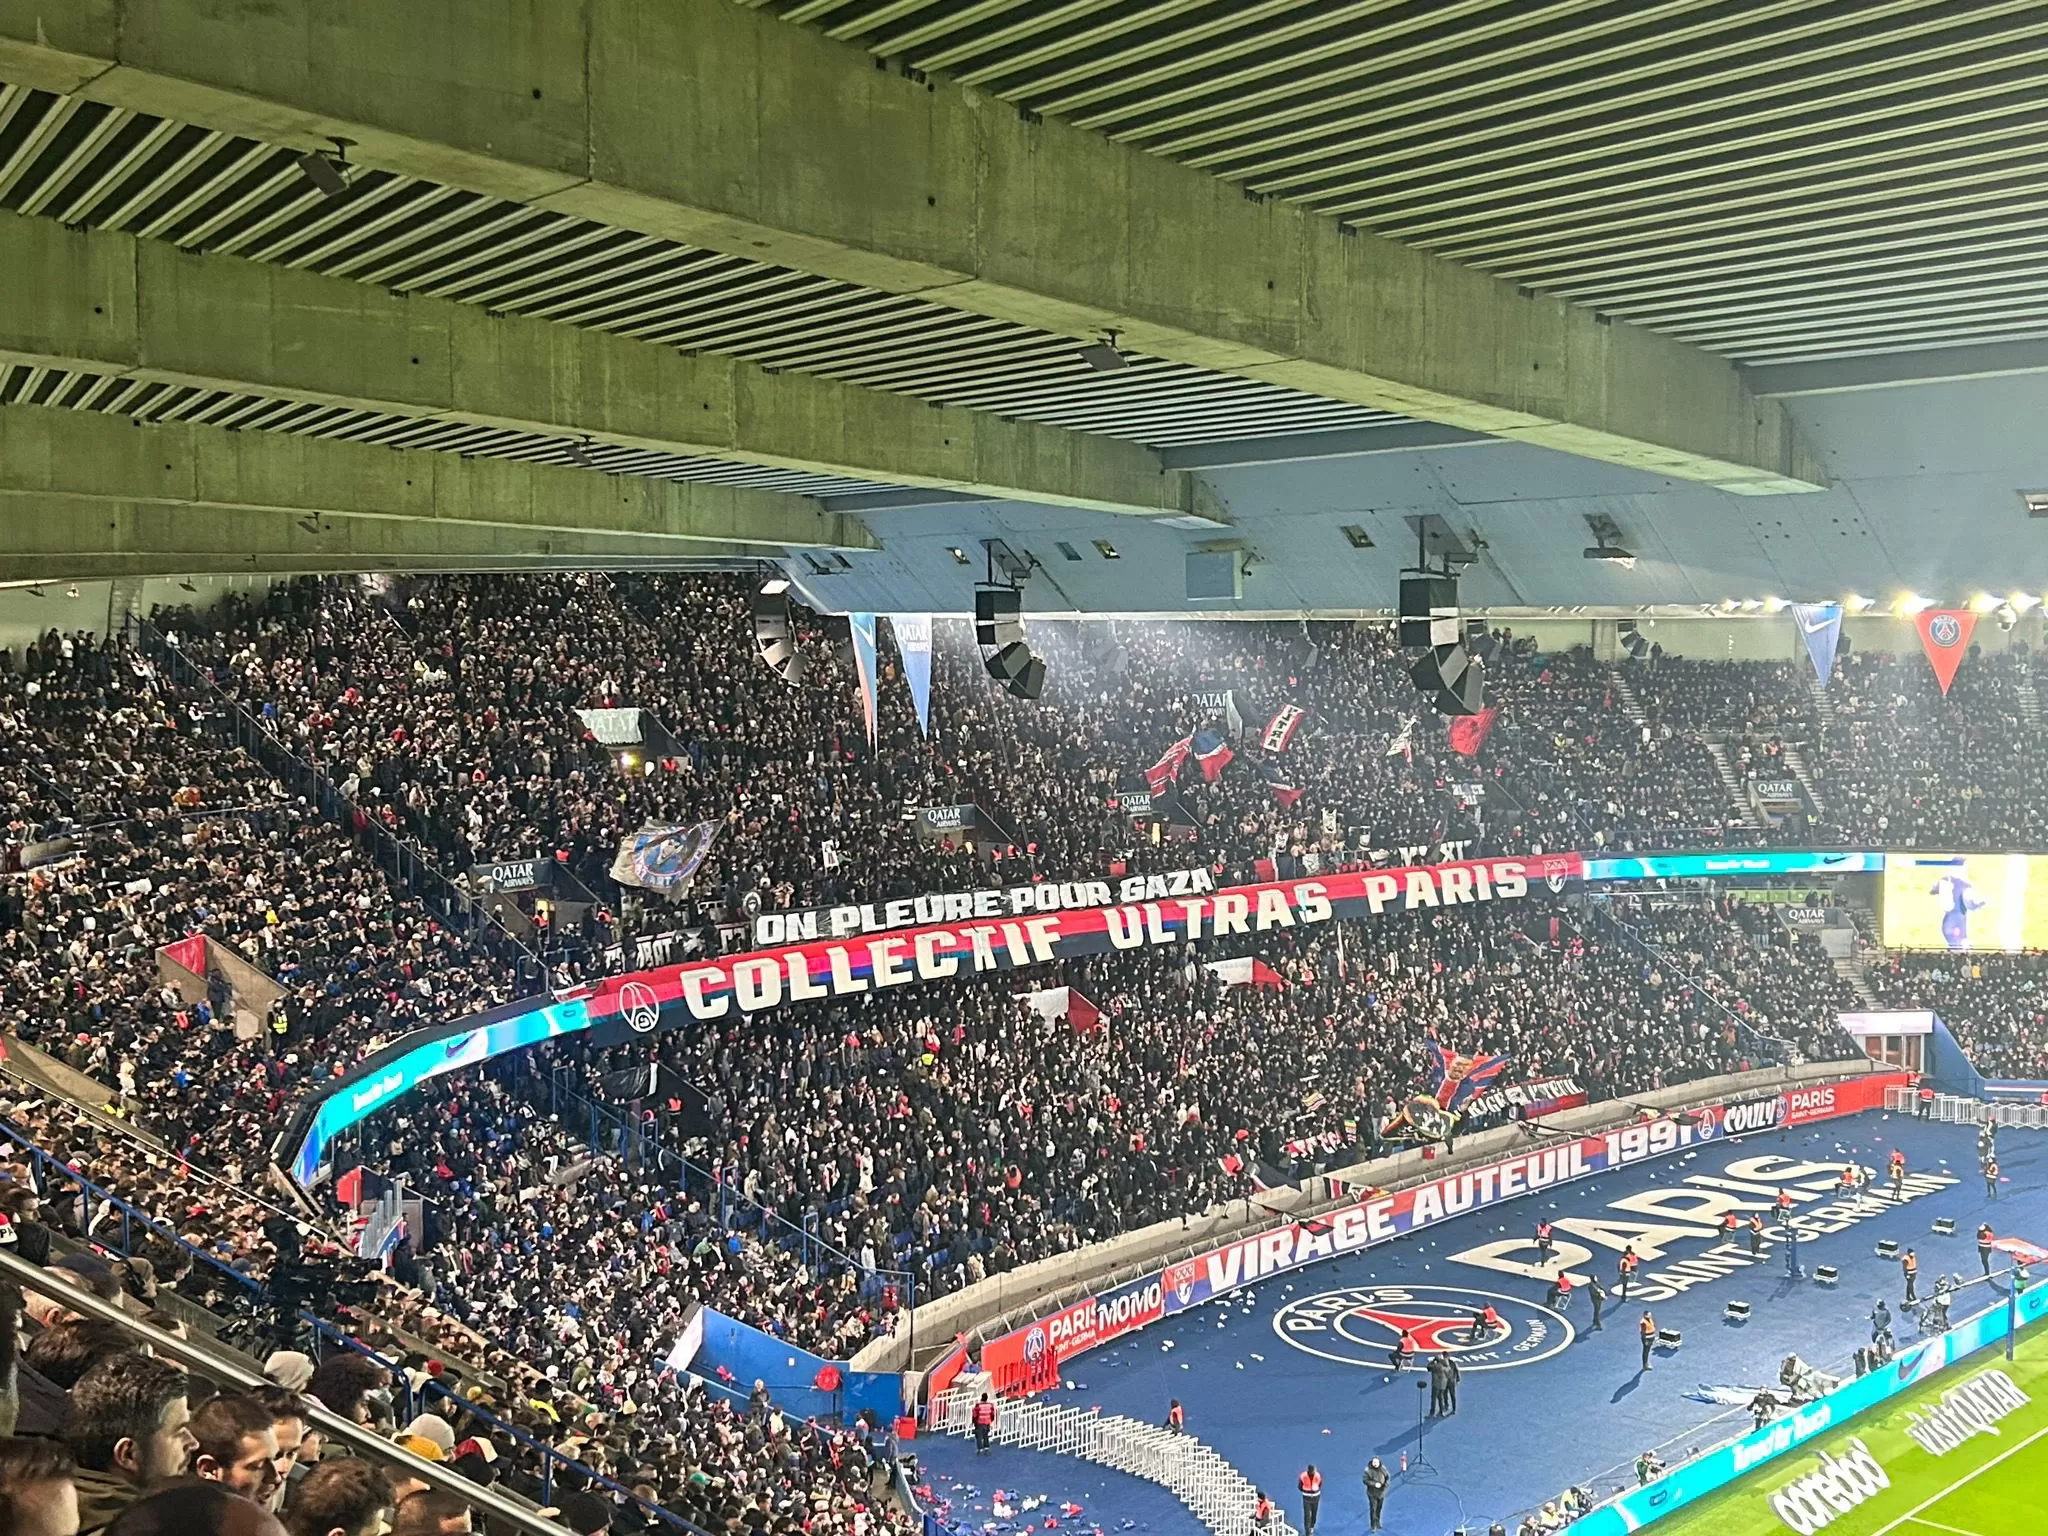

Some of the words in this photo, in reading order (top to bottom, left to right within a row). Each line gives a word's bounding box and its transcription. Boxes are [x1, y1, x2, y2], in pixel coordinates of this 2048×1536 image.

[1757, 783, 1793, 795] QATAR
[1122, 794, 1150, 809] QATAR
[927, 808, 961, 824] QATAR
[487, 863, 534, 883] QATAR
[503, 876, 535, 889] AIRWAYS
[757, 911, 818, 945] ON
[831, 890, 1003, 938] PLEURE
[1010, 881, 1112, 914] POUR
[1119, 868, 1215, 903] GAZA
[1788, 909, 1825, 921] QATAR
[680, 916, 1061, 1020] COLLECTIF
[1102, 882, 1332, 950] ULTRAS
[1361, 861, 1528, 914] PARIS
[1791, 1088, 1835, 1111] PARIS
[1791, 1105, 1835, 1120] SAINT-GERMAIN
[1206, 1199, 1397, 1292] VIRAGE
[1412, 1139, 1591, 1231] AUTEUIL
[1606, 1116, 1692, 1166] 1991
[1445, 1155, 1877, 1287] PARIS
[1097, 1282, 1161, 1331] MOMO
[1286, 1289, 1414, 1331] PARIS
[1771, 1437, 1891, 1536] ooredoo
